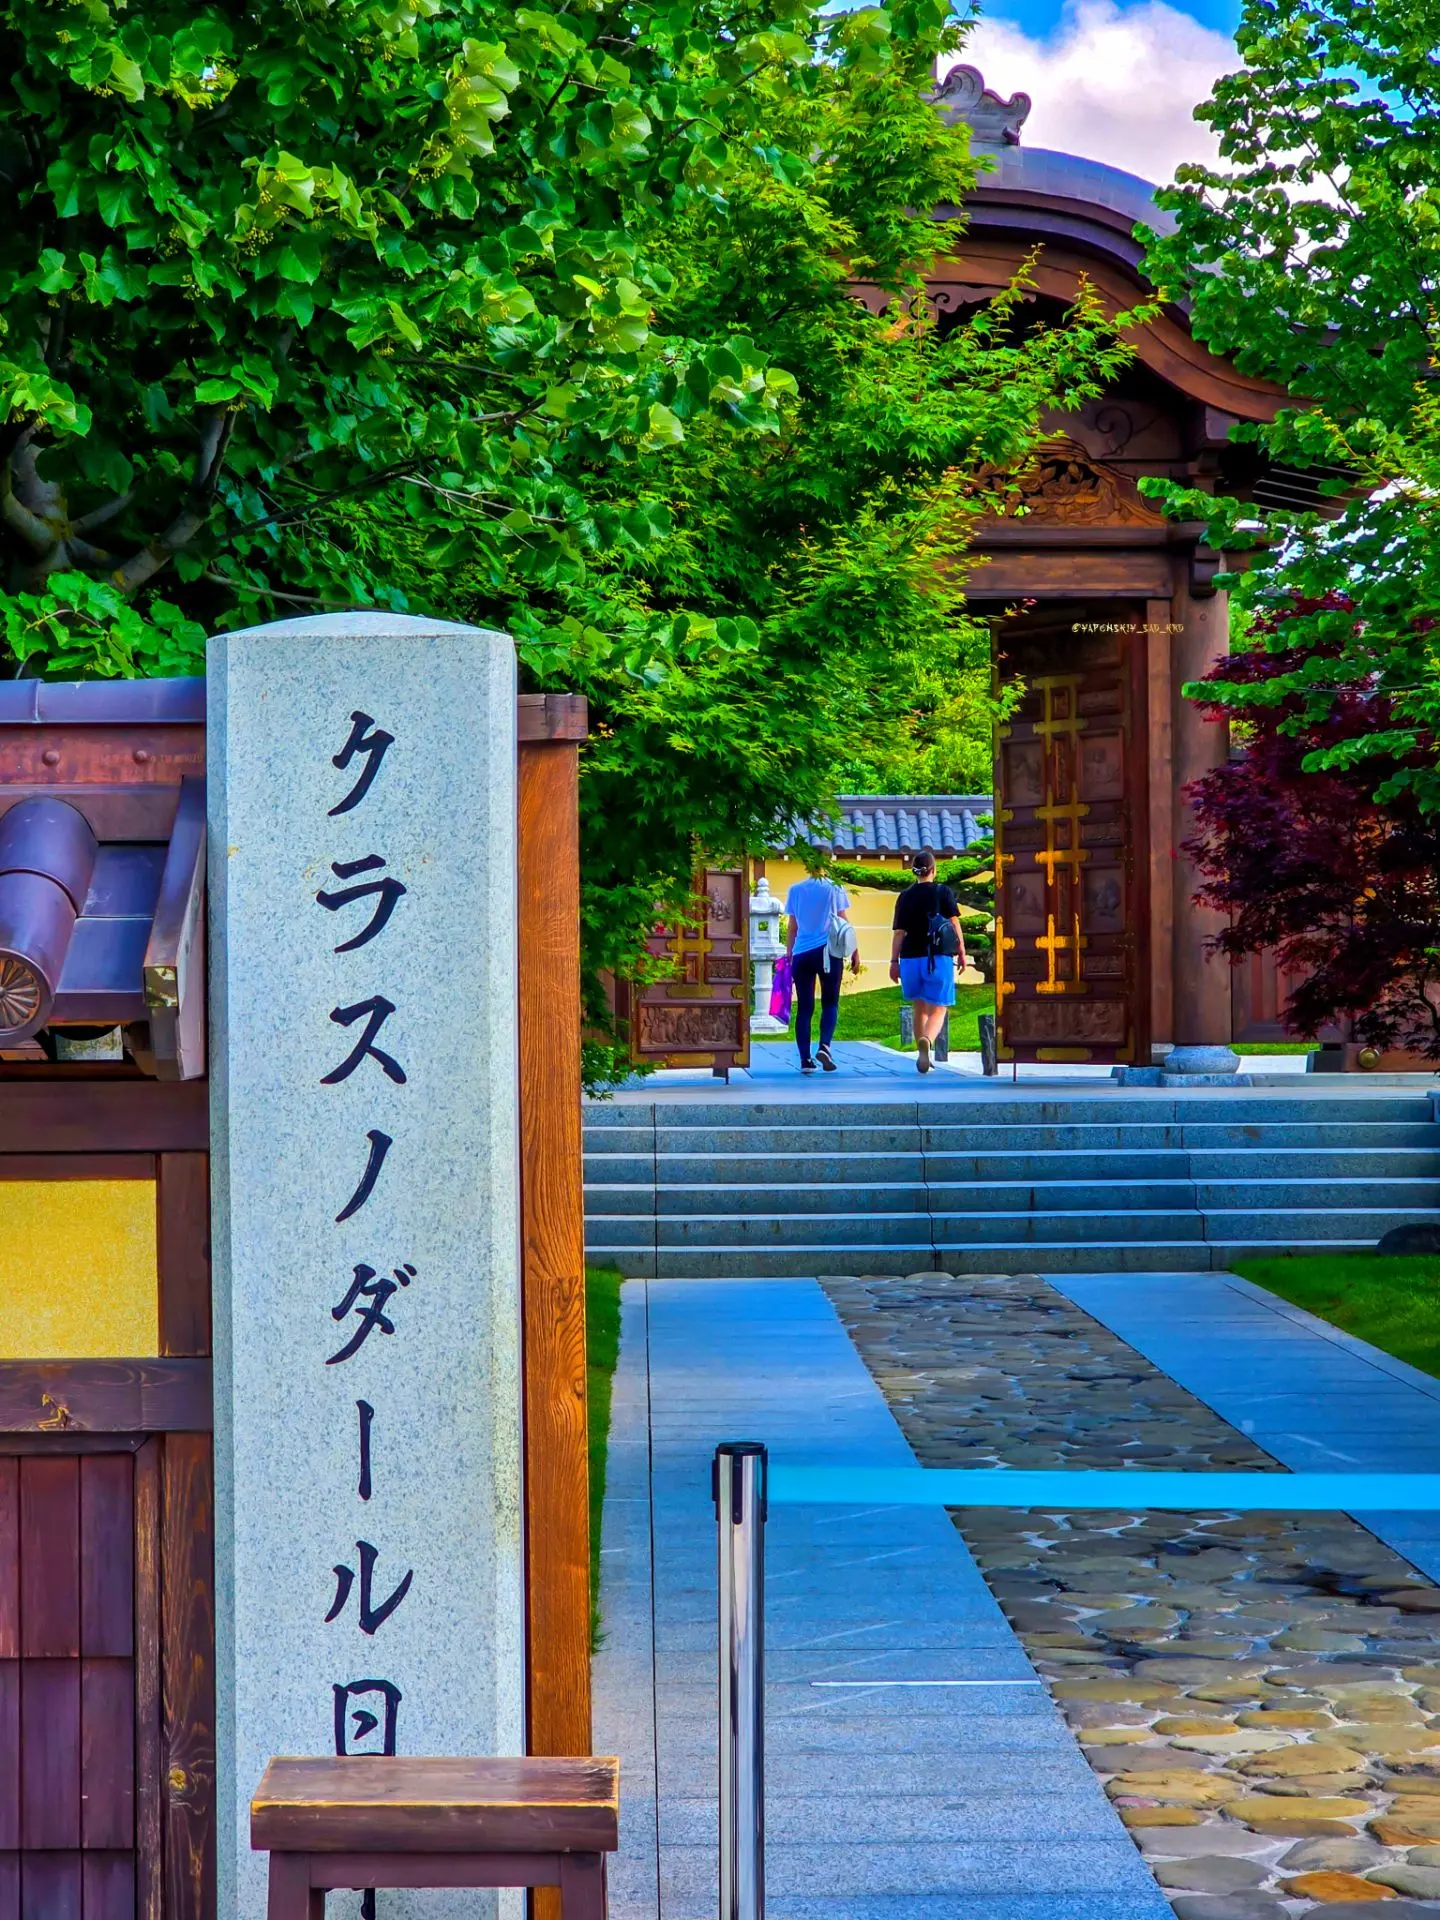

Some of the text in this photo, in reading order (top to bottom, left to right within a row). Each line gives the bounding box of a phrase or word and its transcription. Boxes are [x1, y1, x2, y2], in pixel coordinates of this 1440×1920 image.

[316, 710, 418, 1920] クラスノダール日
